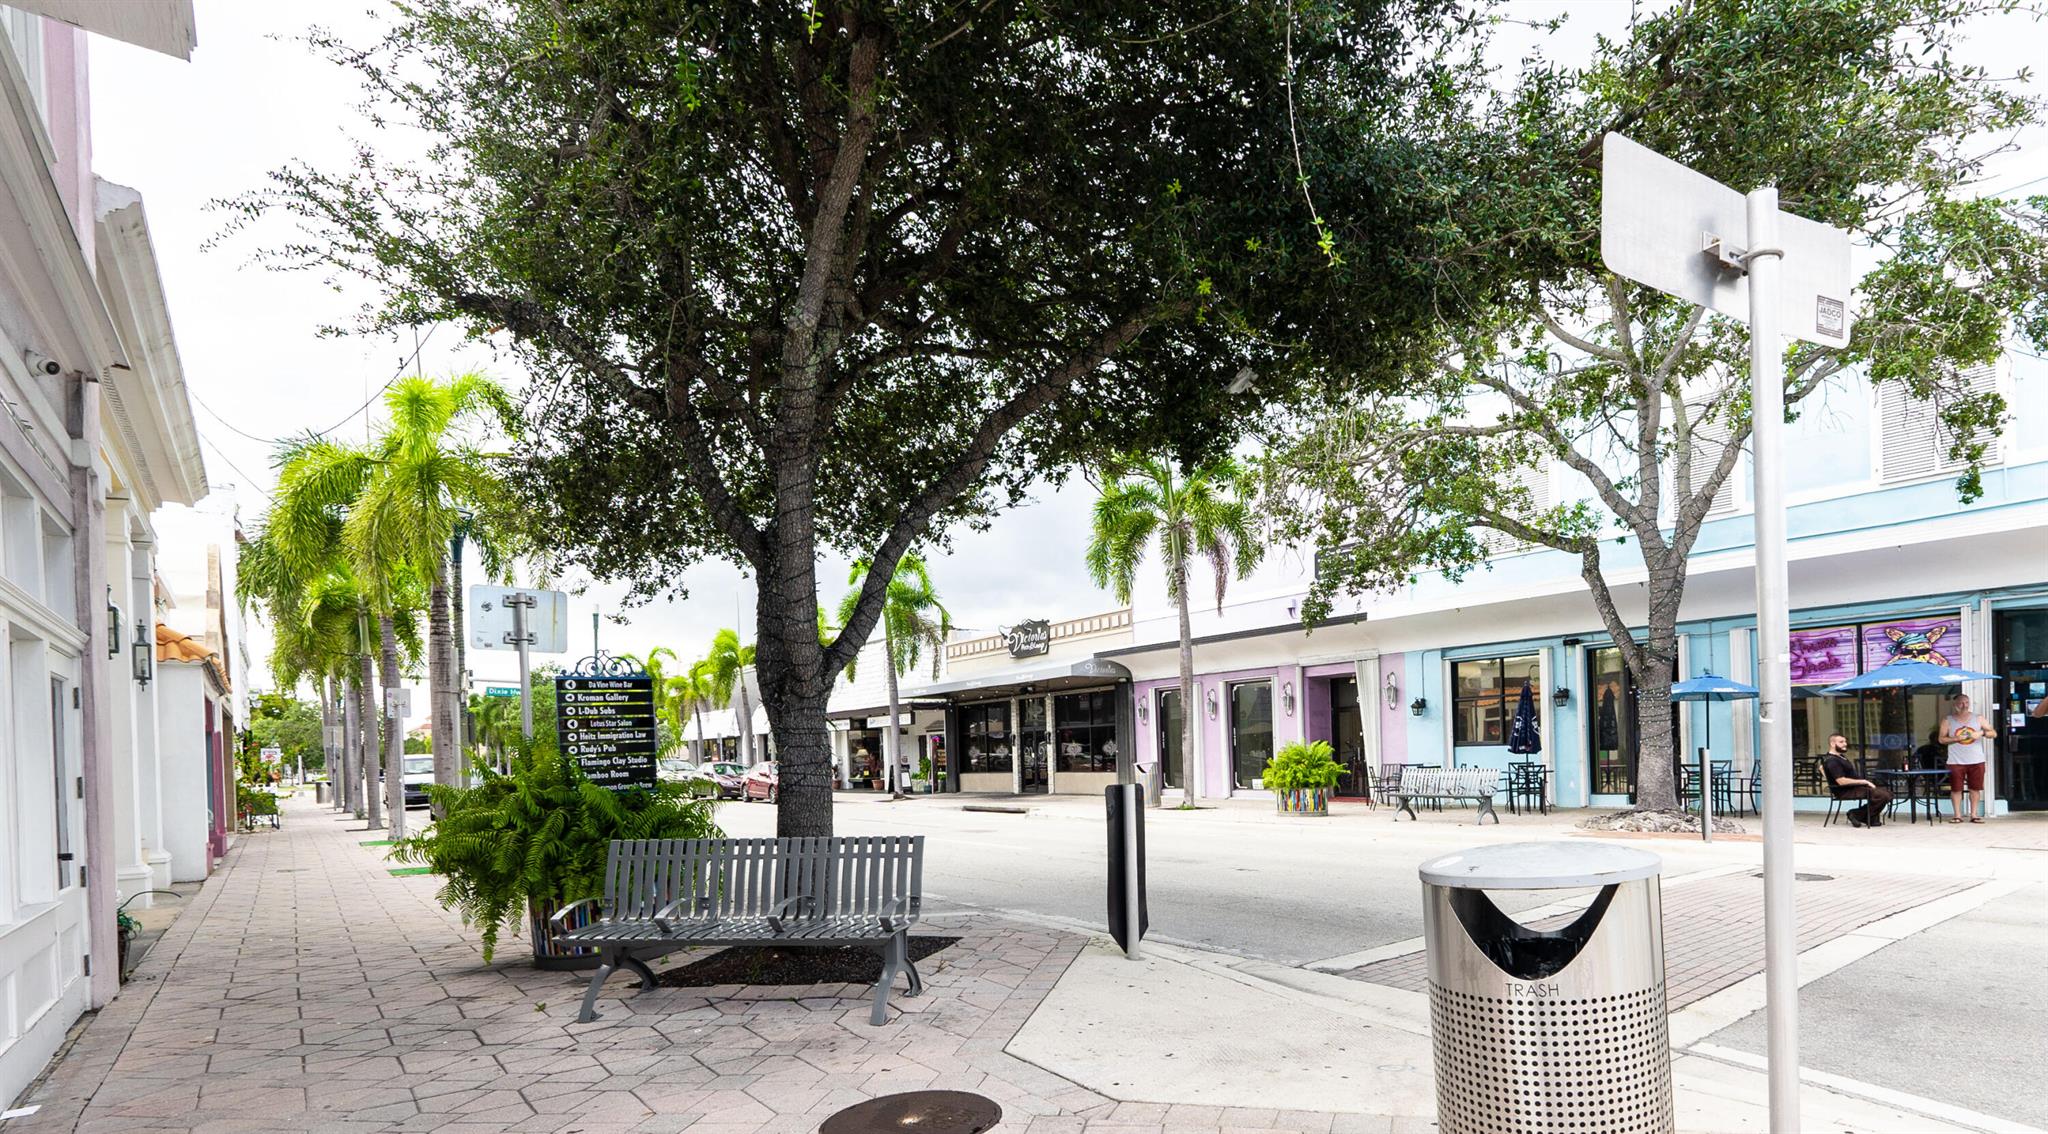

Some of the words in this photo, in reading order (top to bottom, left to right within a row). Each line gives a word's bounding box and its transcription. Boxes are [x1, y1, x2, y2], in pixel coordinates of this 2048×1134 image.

[1819, 307, 1841, 318] JADCO
[578, 694, 604, 702] Kroman
[605, 693, 629, 702] Gallery
[578, 707, 599, 715] L-Dub
[600, 706, 616, 715] Subs
[590, 720, 605, 728] Lotus
[617, 719, 633, 727] Salon
[579, 732, 596, 740] Heitz
[597, 731, 634, 741] Immigration
[635, 731, 647, 739] Law
[580, 745, 601, 754] Rudy's
[603, 744, 617, 752] Pub
[581, 758, 611, 767] Flamingo
[612, 757, 627, 766] Clay
[628, 756, 648, 764] Studio
[610, 770, 629, 778] Room
[1505, 983, 1559, 997] TRASH
